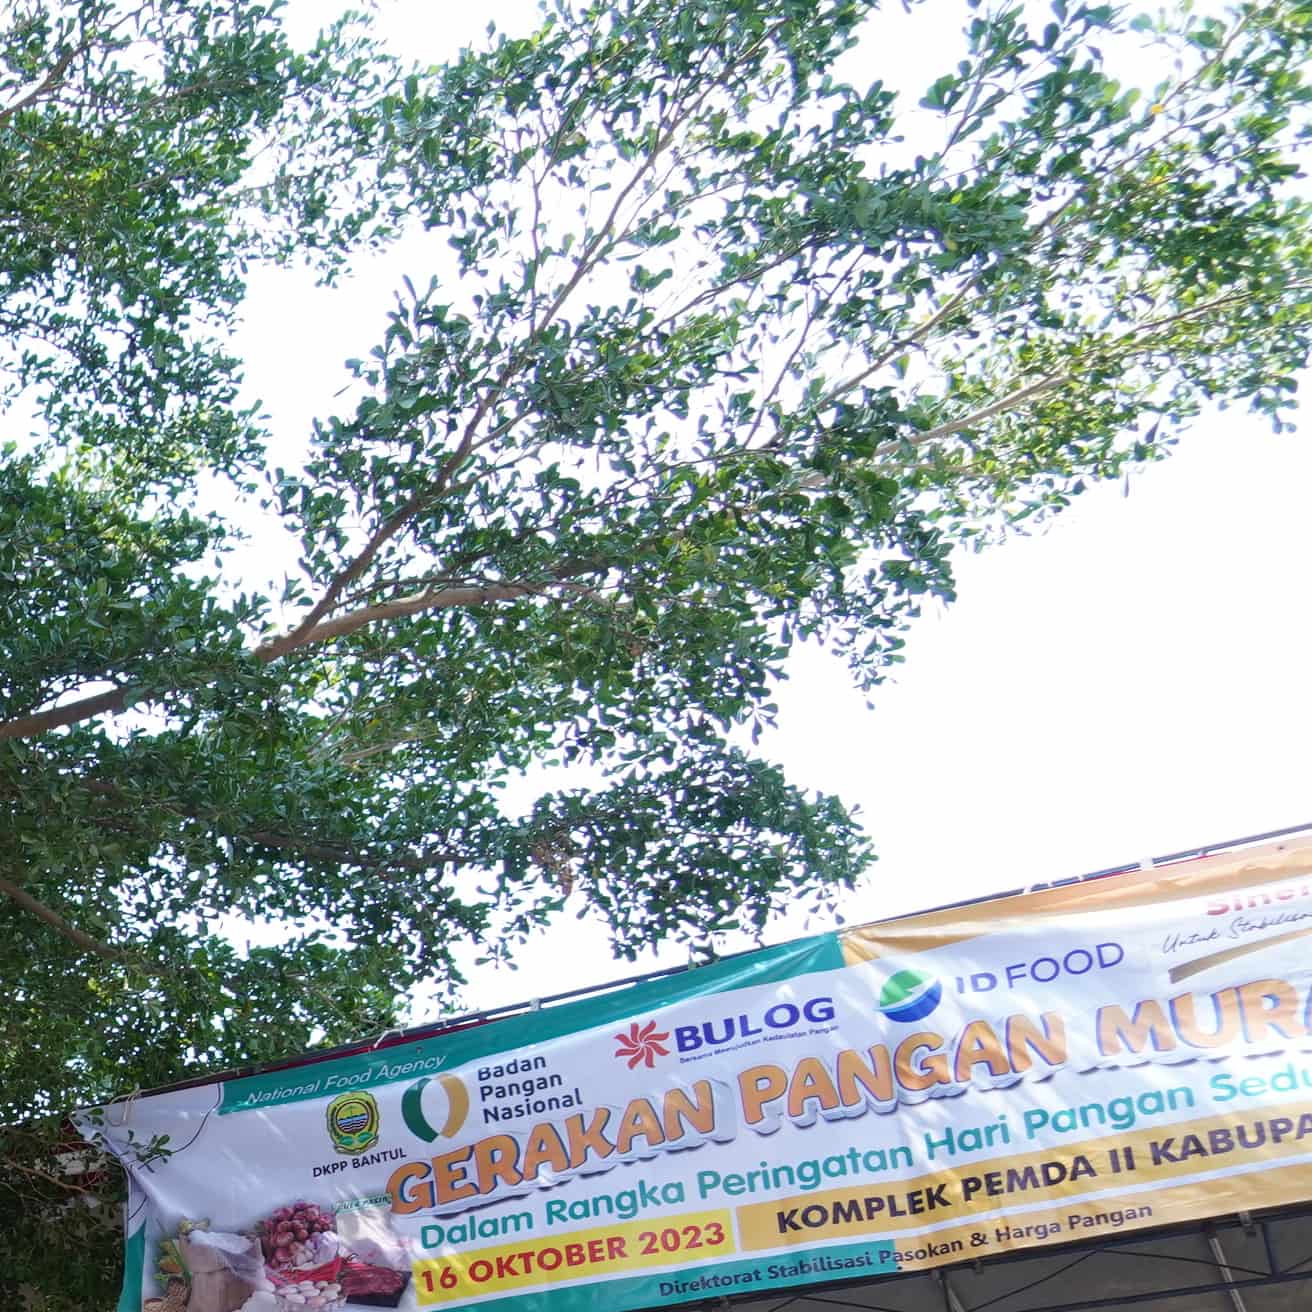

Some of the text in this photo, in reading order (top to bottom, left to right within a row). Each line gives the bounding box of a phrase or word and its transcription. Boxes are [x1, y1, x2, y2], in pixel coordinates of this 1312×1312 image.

[955, 942, 1124, 995] ID FOOD
[675, 997, 836, 1053] BULOG
[245, 1055, 446, 1105] National Food Agency
[478, 1055, 546, 1082] Badan
[480, 1072, 562, 1102] Pangan
[386, 979, 1312, 1216] GERAKAN PANGAN MUR
[483, 1087, 583, 1124] Nasional
[312, 1147, 407, 1178] DKPP BANTUL
[420, 1209, 534, 1250] Dalam
[545, 1178, 686, 1226] Rangka
[698, 1145, 914, 1200] Peringatan
[925, 1118, 1010, 1162] Hari
[1025, 1082, 1195, 1138] Pangan
[777, 1181, 950, 1234] KOMPLEK
[962, 1155, 1097, 1202] PEMDA
[1108, 1148, 1135, 1174] II
[421, 1221, 726, 1294] 16 OKTOBER 2023
[658, 1205, 1153, 1298] Direktorat Stabilisasi Pasokan & Harga Pangan
